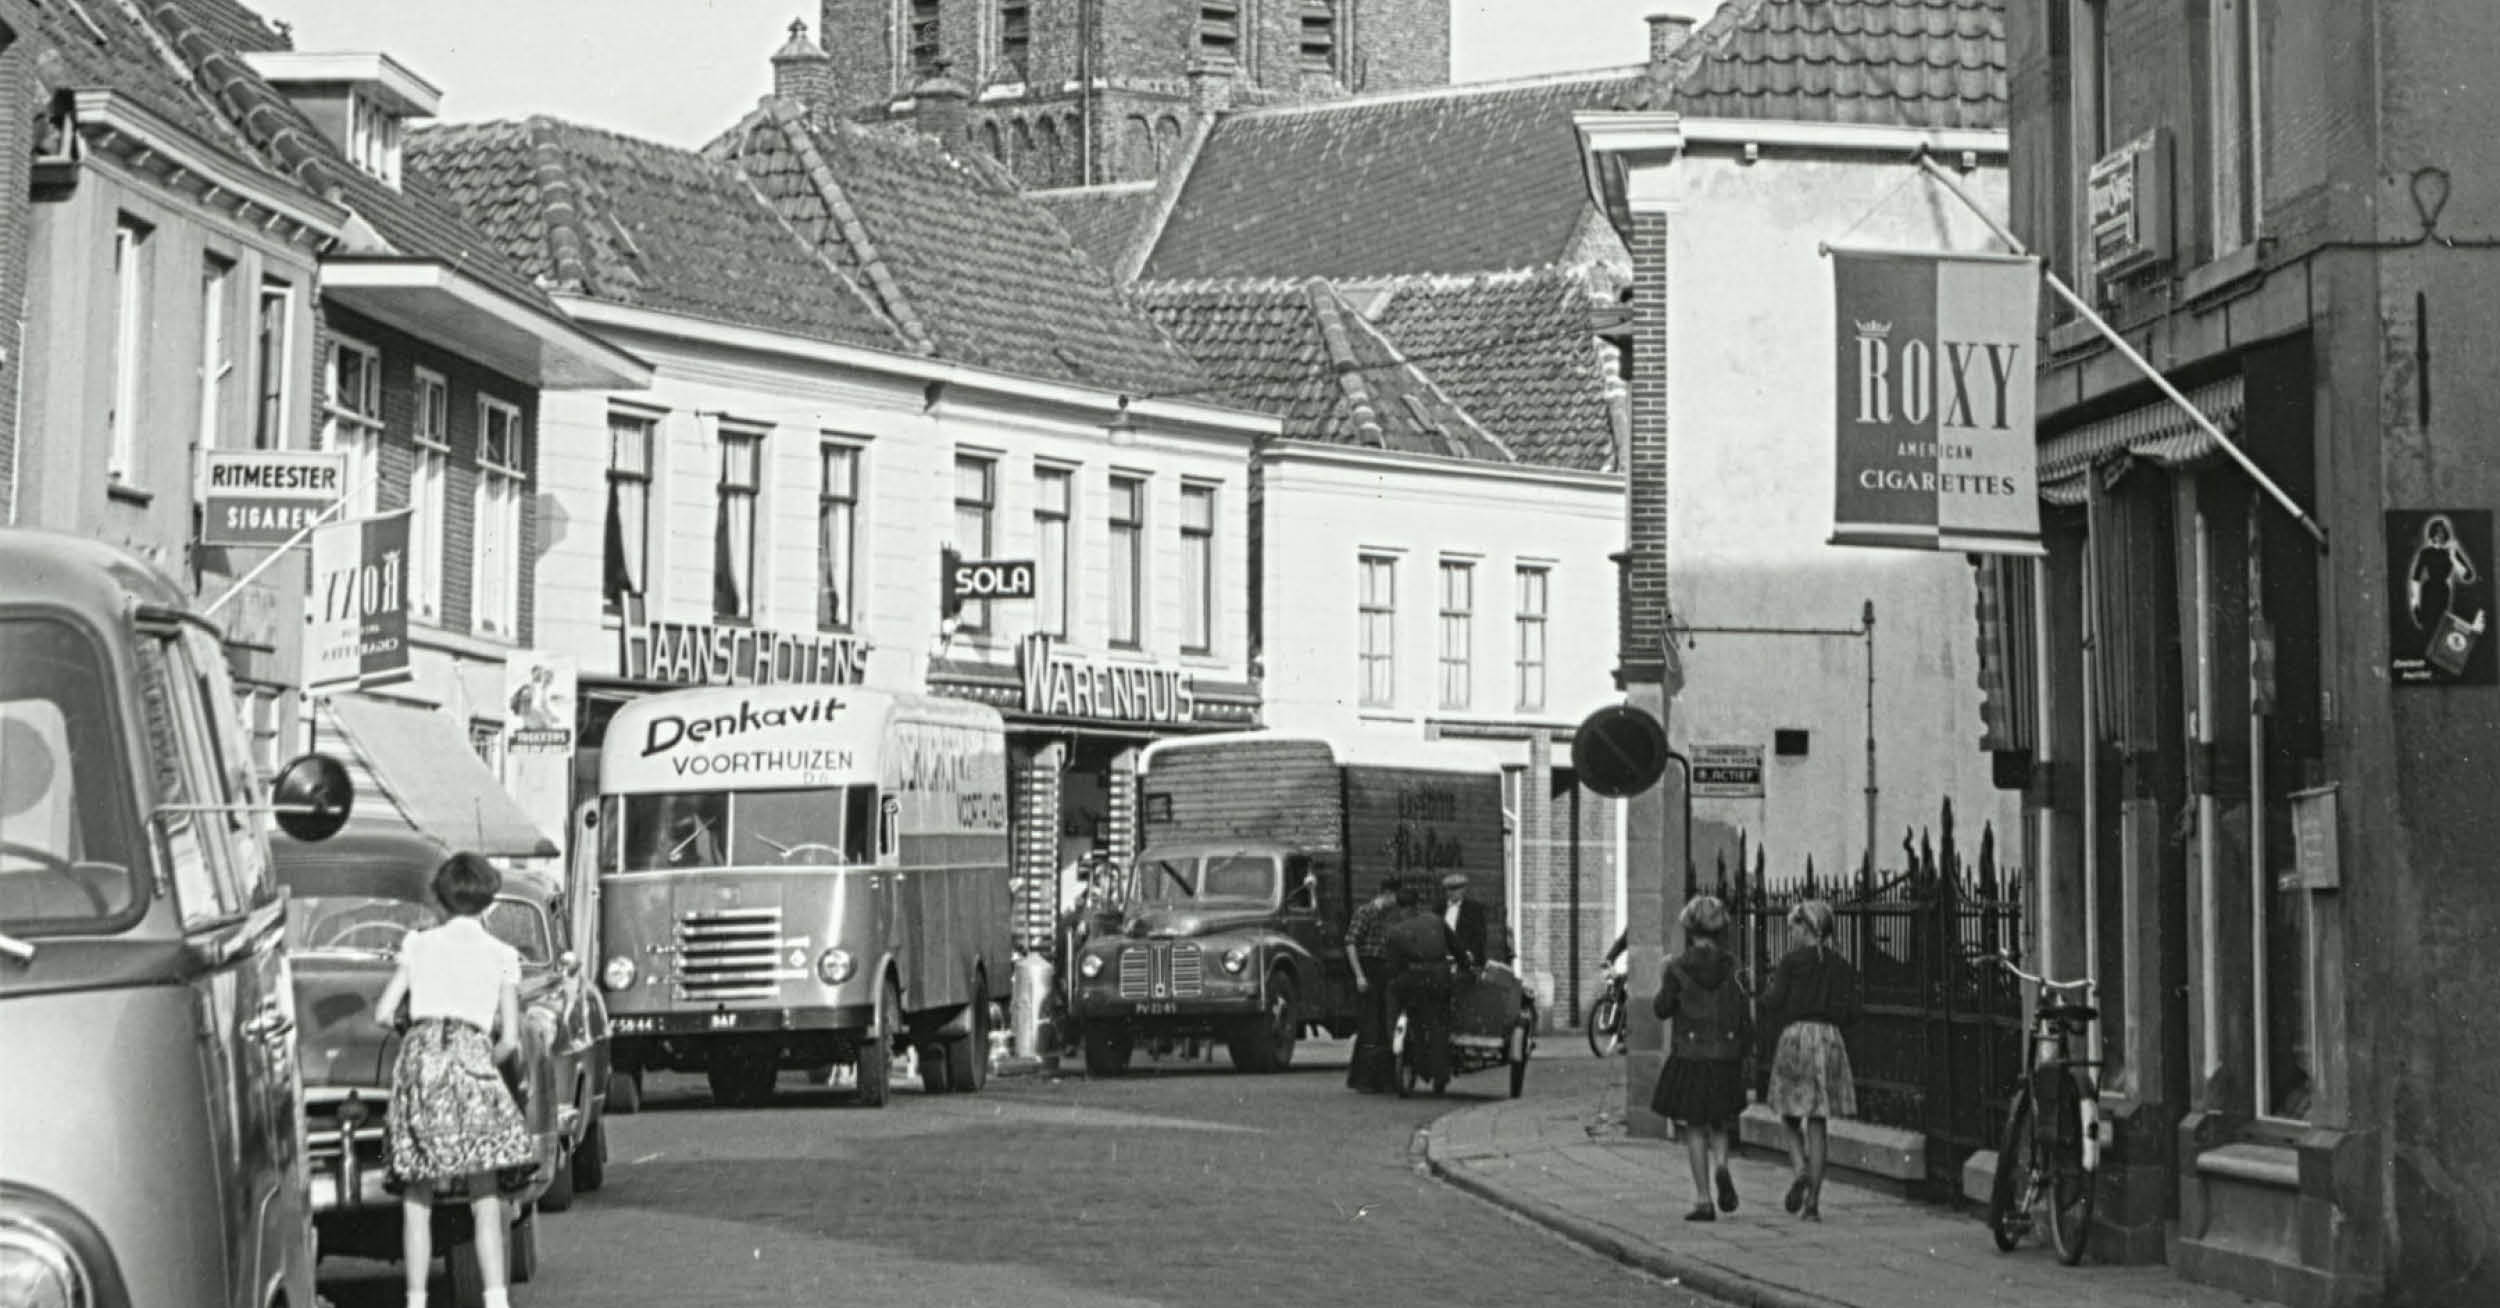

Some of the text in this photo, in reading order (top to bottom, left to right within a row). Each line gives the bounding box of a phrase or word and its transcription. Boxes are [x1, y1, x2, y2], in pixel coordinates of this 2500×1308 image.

[1855, 334, 2020, 430] ROXY
[1897, 442, 1973, 460] AMERICAN
[212, 464, 337, 489] RITMEESTER
[1859, 467, 2016, 496] CIGARETTES
[226, 505, 318, 530] SIGAREN
[954, 565, 1031, 595] SOLA
[621, 588, 872, 687] HAANSCHOTENS
[1022, 633, 1194, 723] WARENHUIS
[640, 697, 847, 758] Denkavit
[671, 749, 854, 777] VOORTHUIZEN
